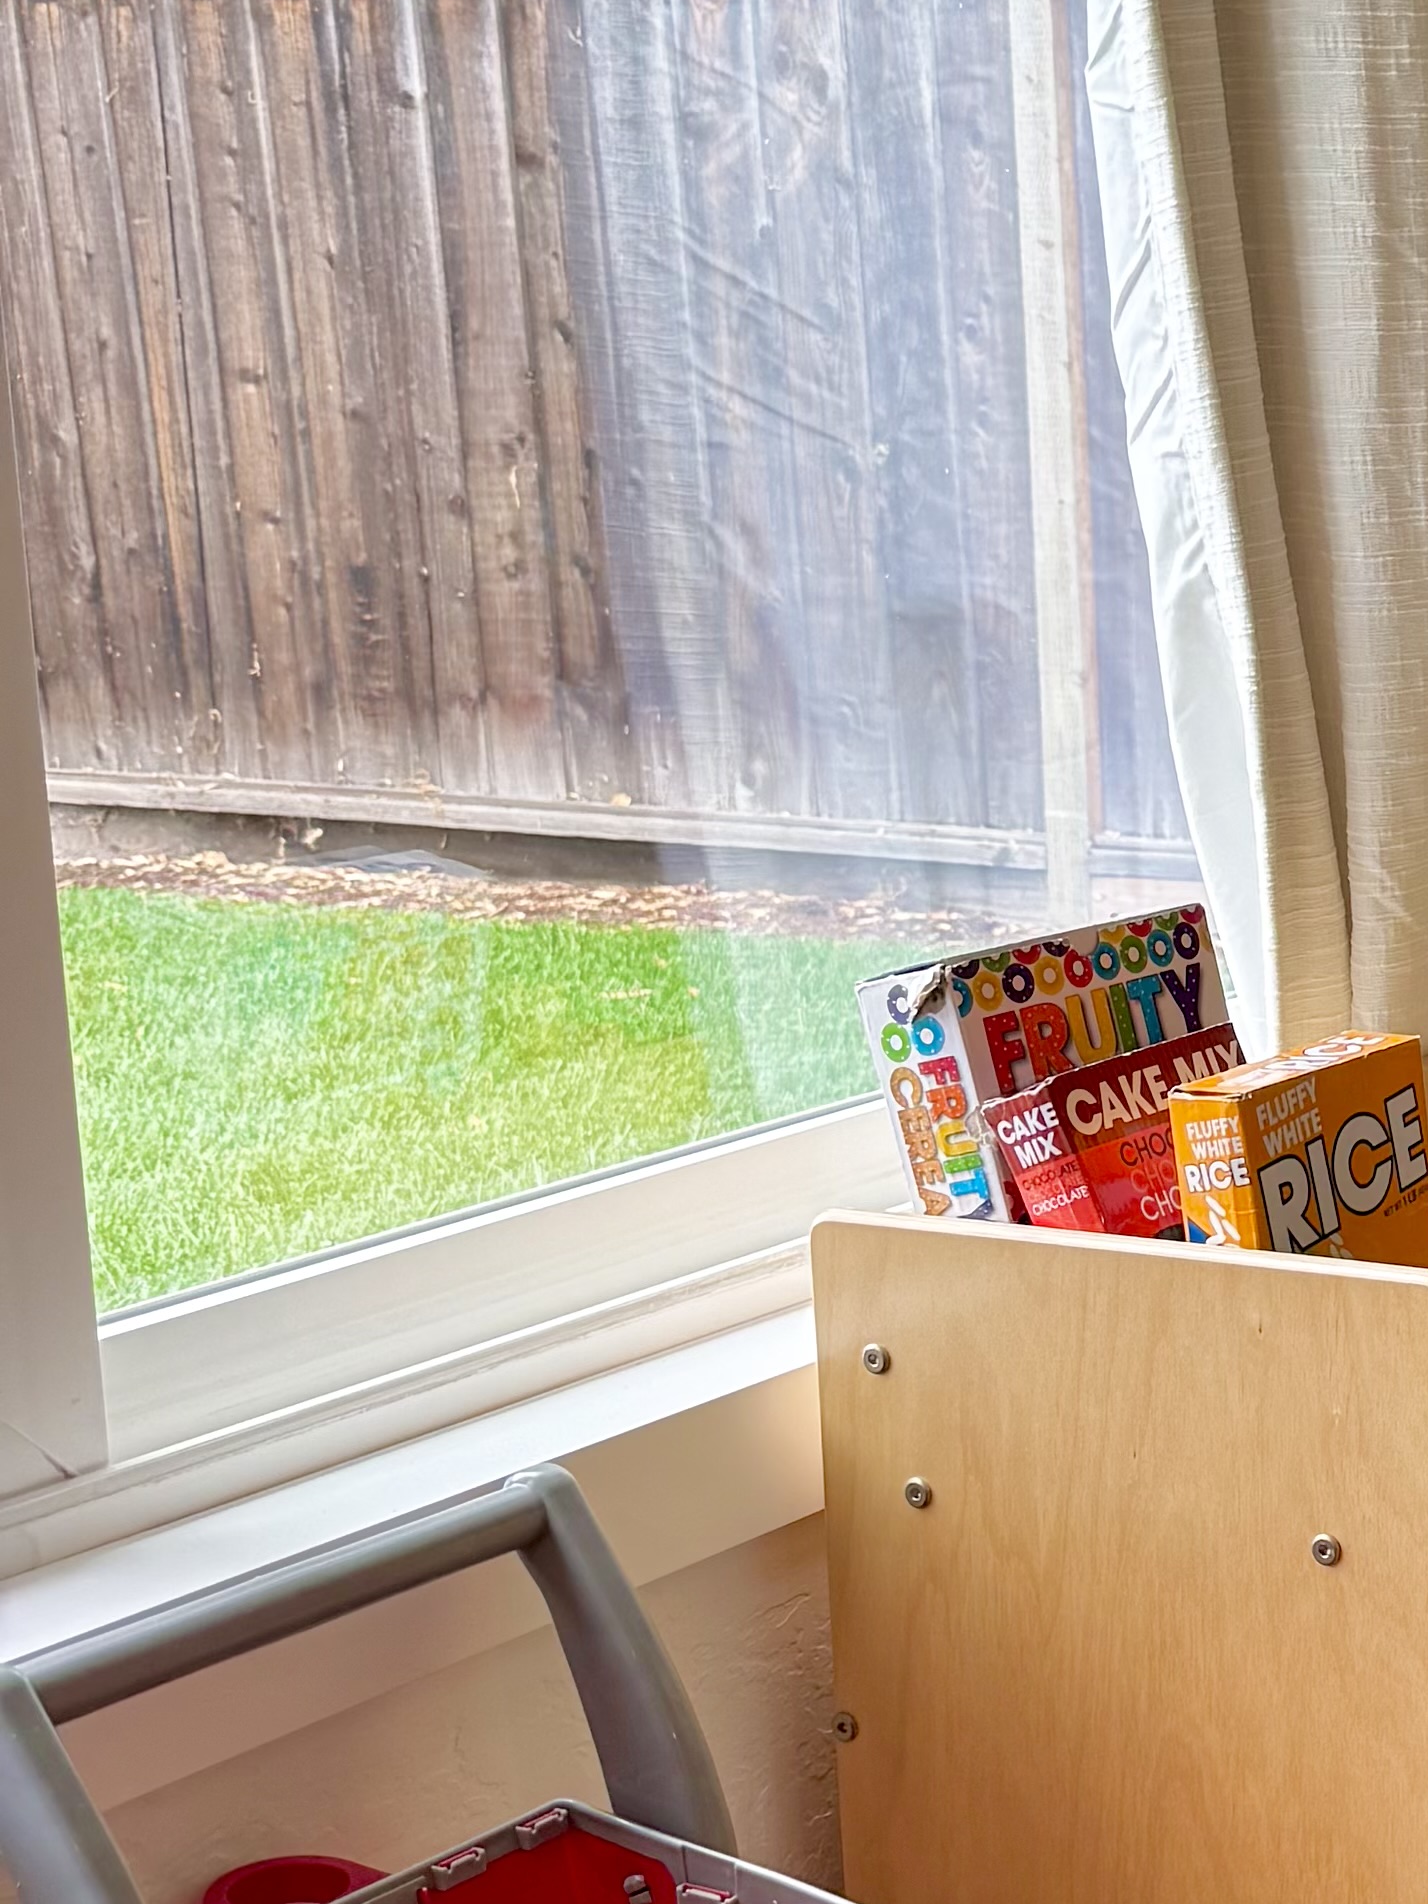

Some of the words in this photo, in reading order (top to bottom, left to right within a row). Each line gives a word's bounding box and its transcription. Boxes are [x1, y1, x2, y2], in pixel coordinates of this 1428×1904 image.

[983, 963, 1201, 1093] FRUITY
[997, 1102, 1060, 1145] CAKE
[1065, 1064, 1168, 1136] CAKE
[1256, 1075, 1317, 1131] FLUFFY
[890, 1066, 951, 1216] CEREA
[1014, 1132, 1062, 1169] MIX
[1184, 1115, 1239, 1141] FLUFFY
[1191, 1136, 1243, 1161] WHITE
[1262, 1107, 1322, 1159] WHITE
[1183, 1156, 1251, 1194] RICE
[1257, 1082, 1428, 1253] RICE
[1032, 1185, 1089, 1216] CHOCOLATE
